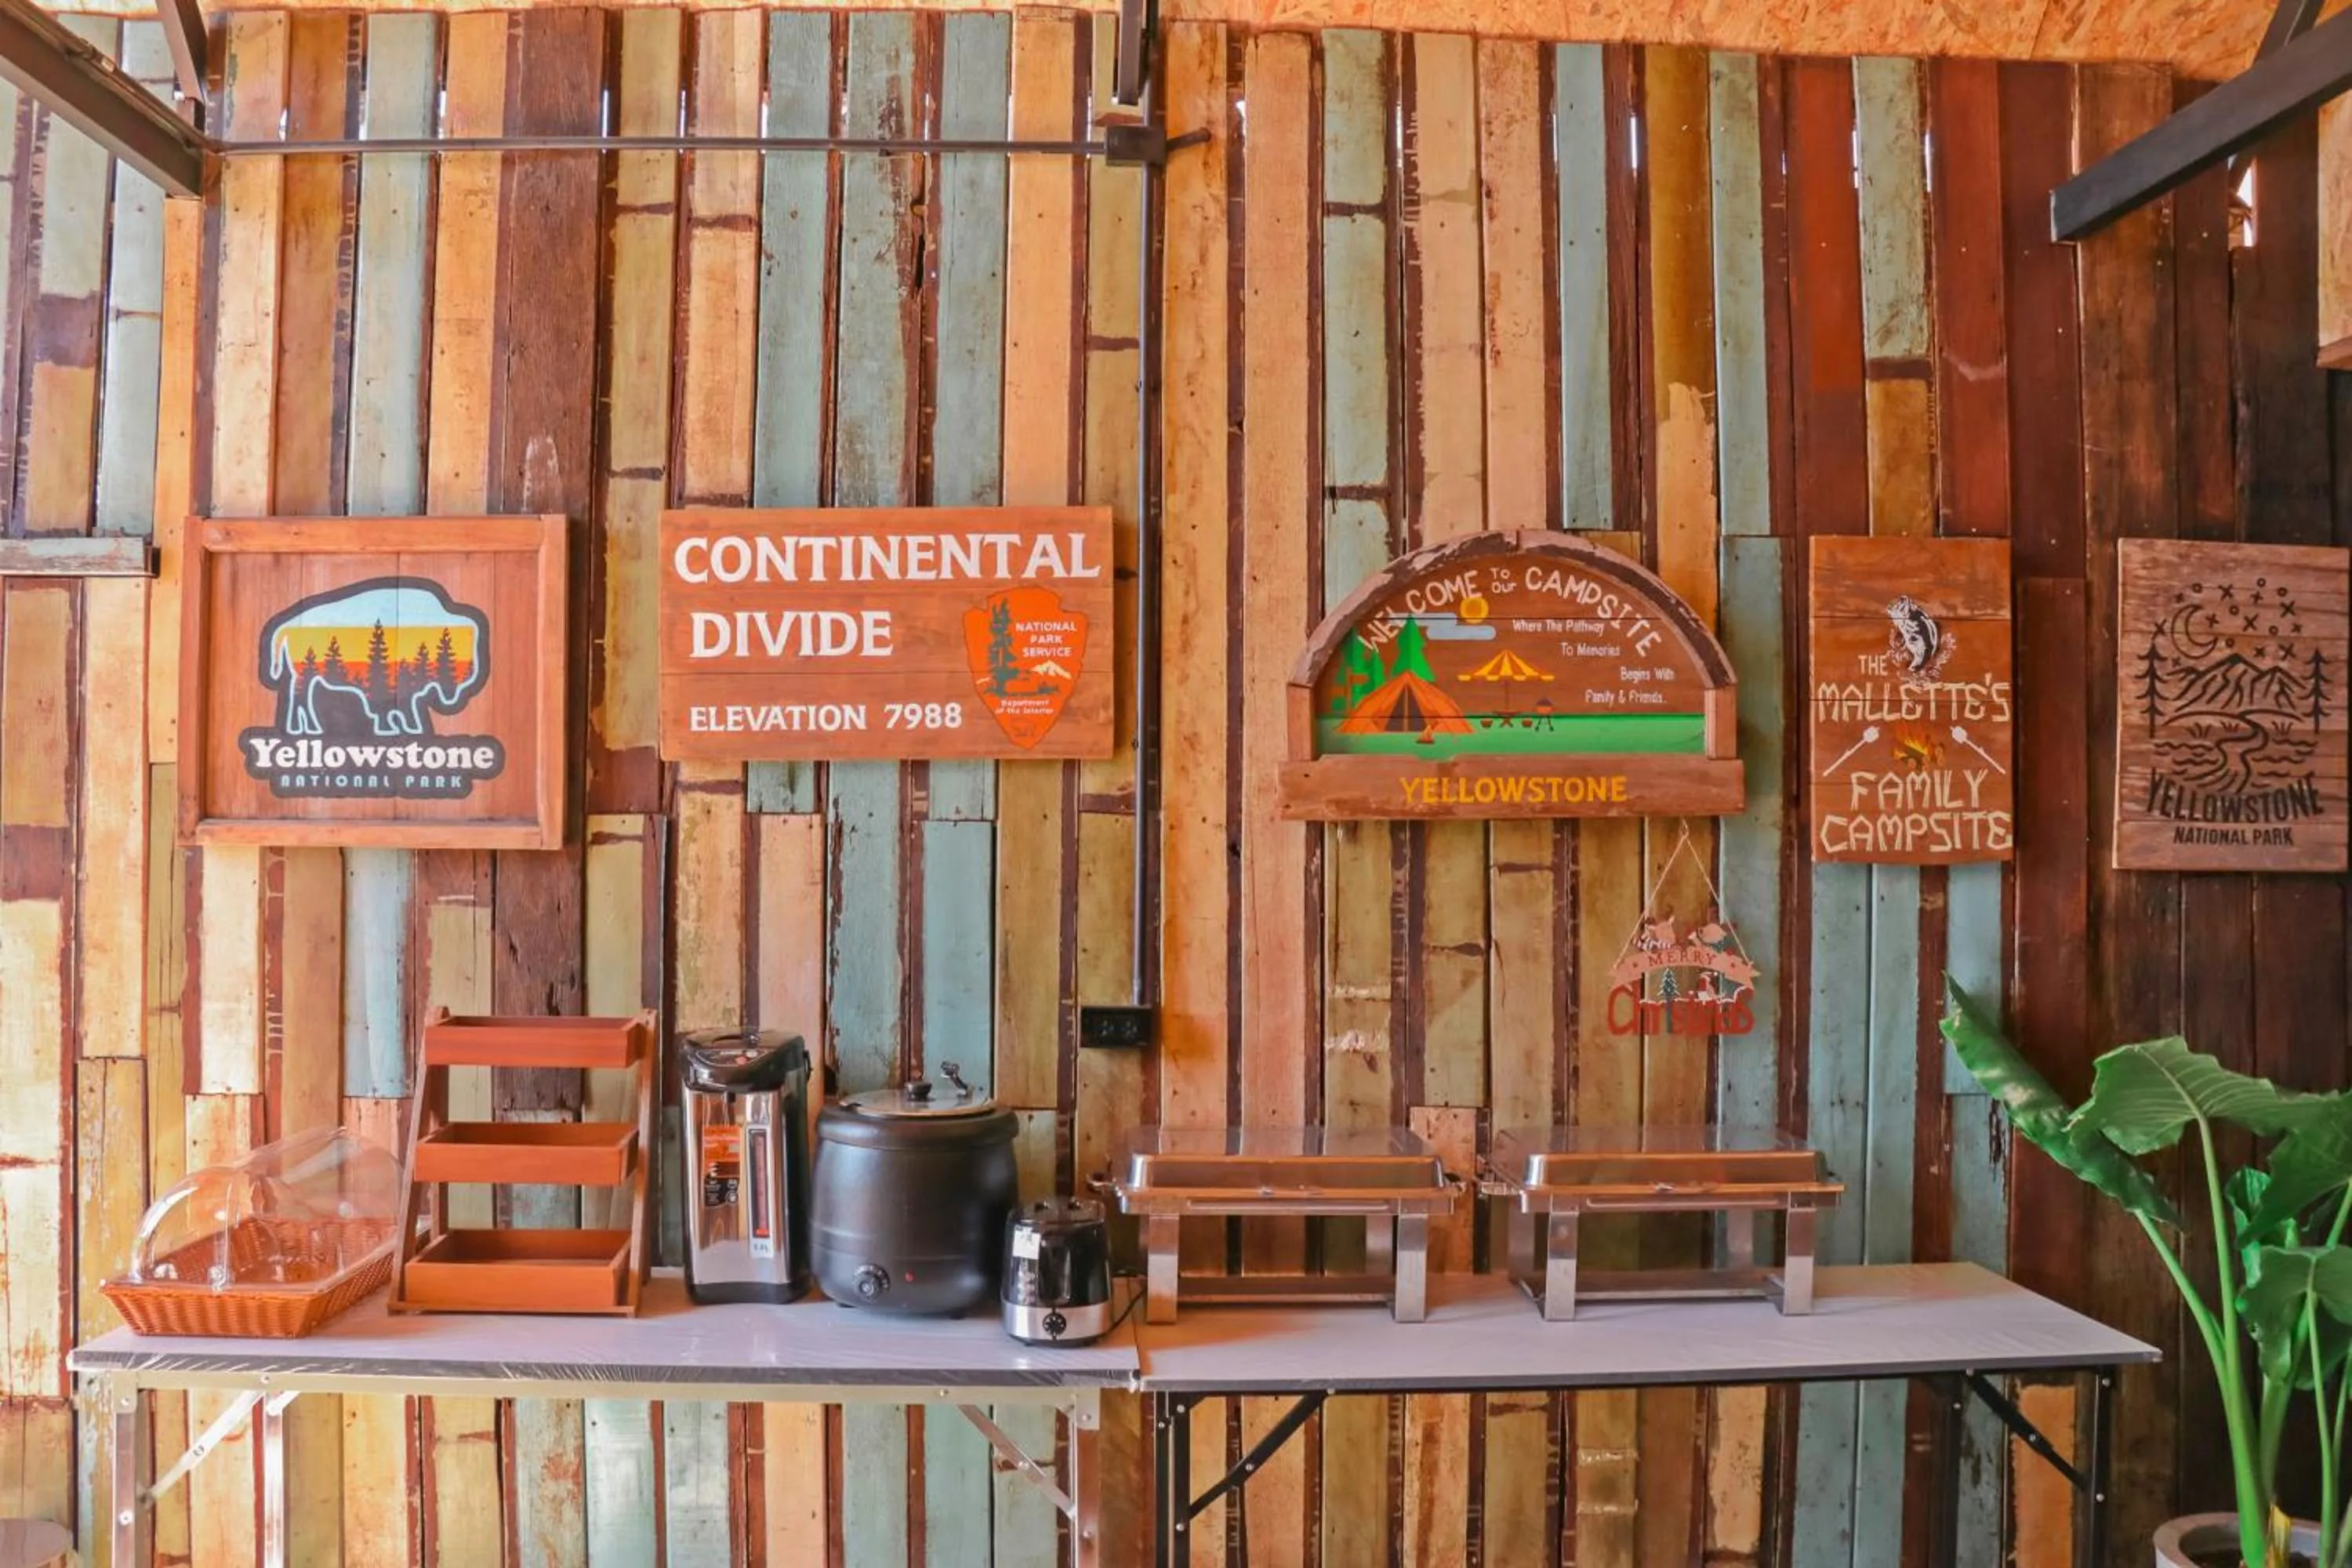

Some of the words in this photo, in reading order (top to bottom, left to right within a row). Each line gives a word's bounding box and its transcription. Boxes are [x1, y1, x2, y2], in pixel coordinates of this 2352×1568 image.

[673, 532, 1102, 584] CONTINENTAL
[1357, 569, 1483, 653] WELCOME
[689, 610, 895, 659] DIVIDE
[1015, 622, 1077, 632] NATIONAL
[1512, 619, 1542, 633] Where
[1546, 619, 1563, 632] The
[1566, 619, 1605, 637] Pathway
[1029, 634, 1063, 644] PARK
[1560, 641, 1573, 657] To
[1577, 643, 1621, 657] Memories
[1022, 647, 1073, 657] SERVICE
[1620, 666, 1650, 684] Begins
[1654, 666, 1675, 681] With
[1857, 655, 1888, 677] THE
[1584, 689, 1615, 708] Family
[1817, 672, 2011, 723] MALLETTE'S
[689, 704, 867, 732] ELEVATION
[883, 702, 963, 729] 7988
[249, 738, 495, 769] Yellowstone
[280, 775, 390, 788] NATIONAL
[405, 775, 463, 788] PARK
[1399, 775, 1628, 804] YELLOWSTONE
[1850, 769, 1989, 811] FAMILY
[2146, 767, 2325, 824] YELLOWSTONE
[1820, 810, 2013, 854] CAMPSITE
[2172, 826, 2249, 845] NATIONAL
[2252, 827, 2294, 845] PARK
[1649, 951, 1717, 967] MERRY
